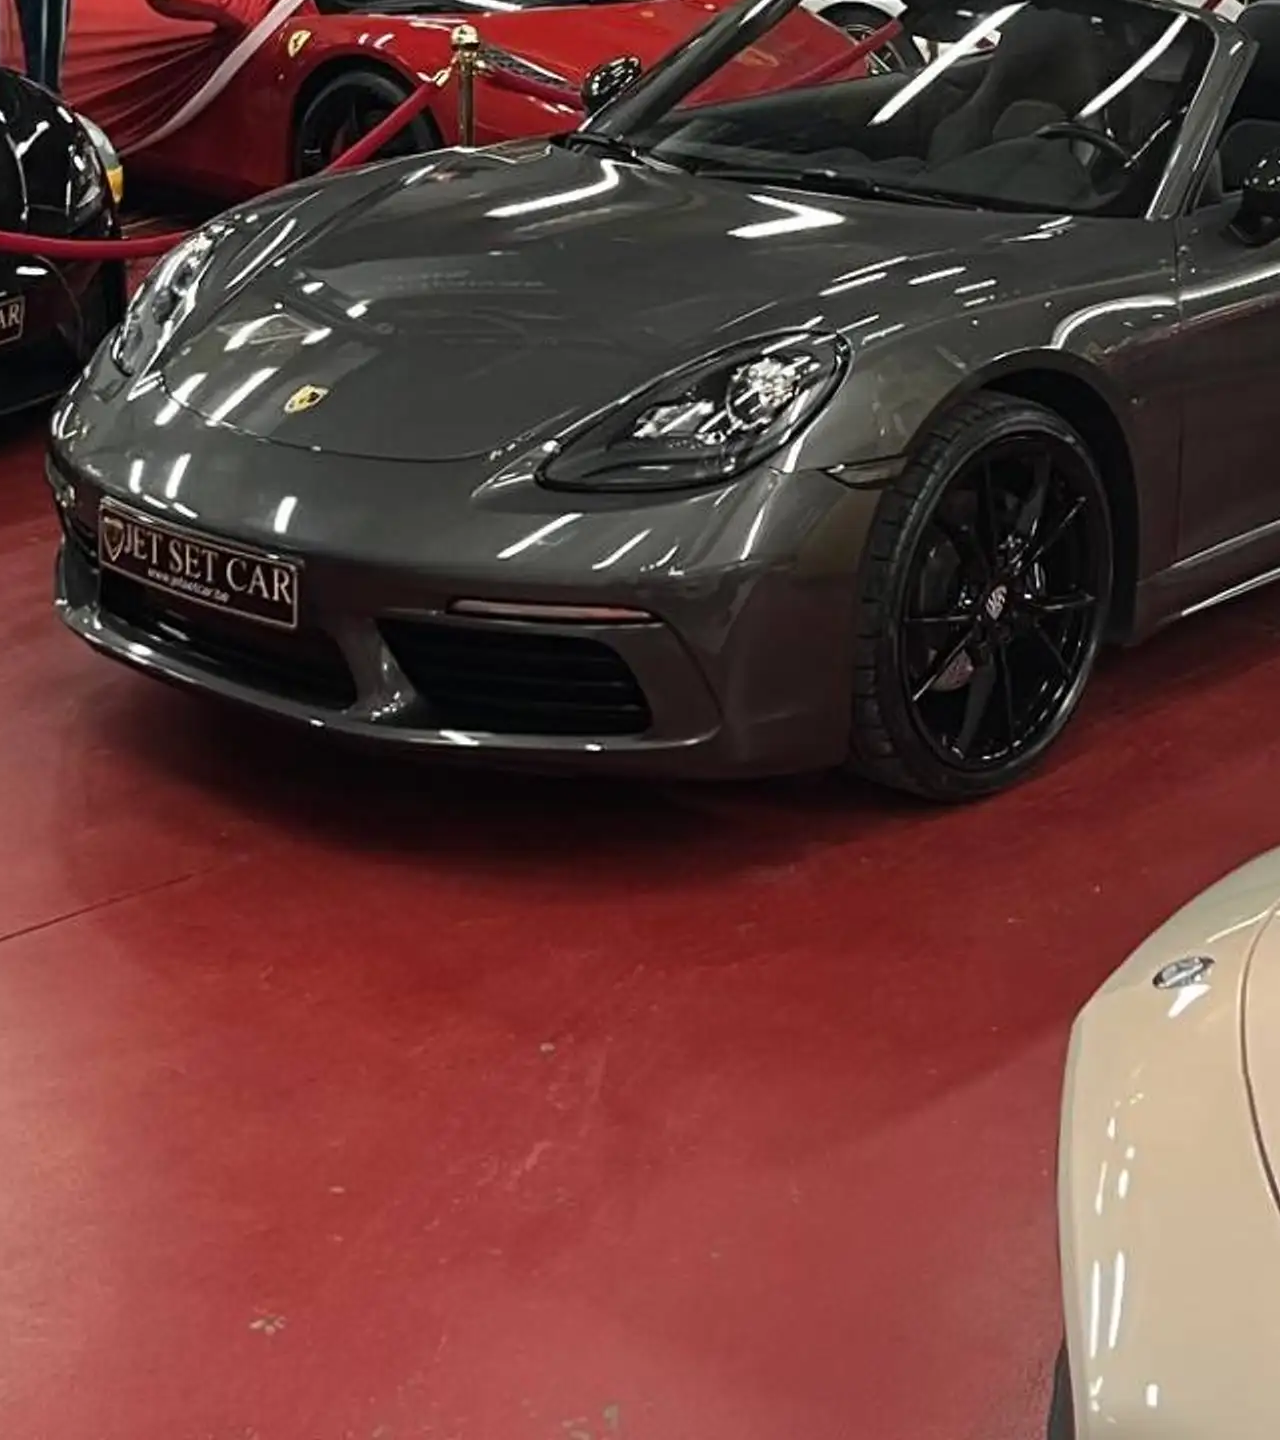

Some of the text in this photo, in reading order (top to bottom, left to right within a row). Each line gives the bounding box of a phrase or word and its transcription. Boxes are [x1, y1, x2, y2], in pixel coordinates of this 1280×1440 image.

[123, 522, 293, 606] JET SET CAR
